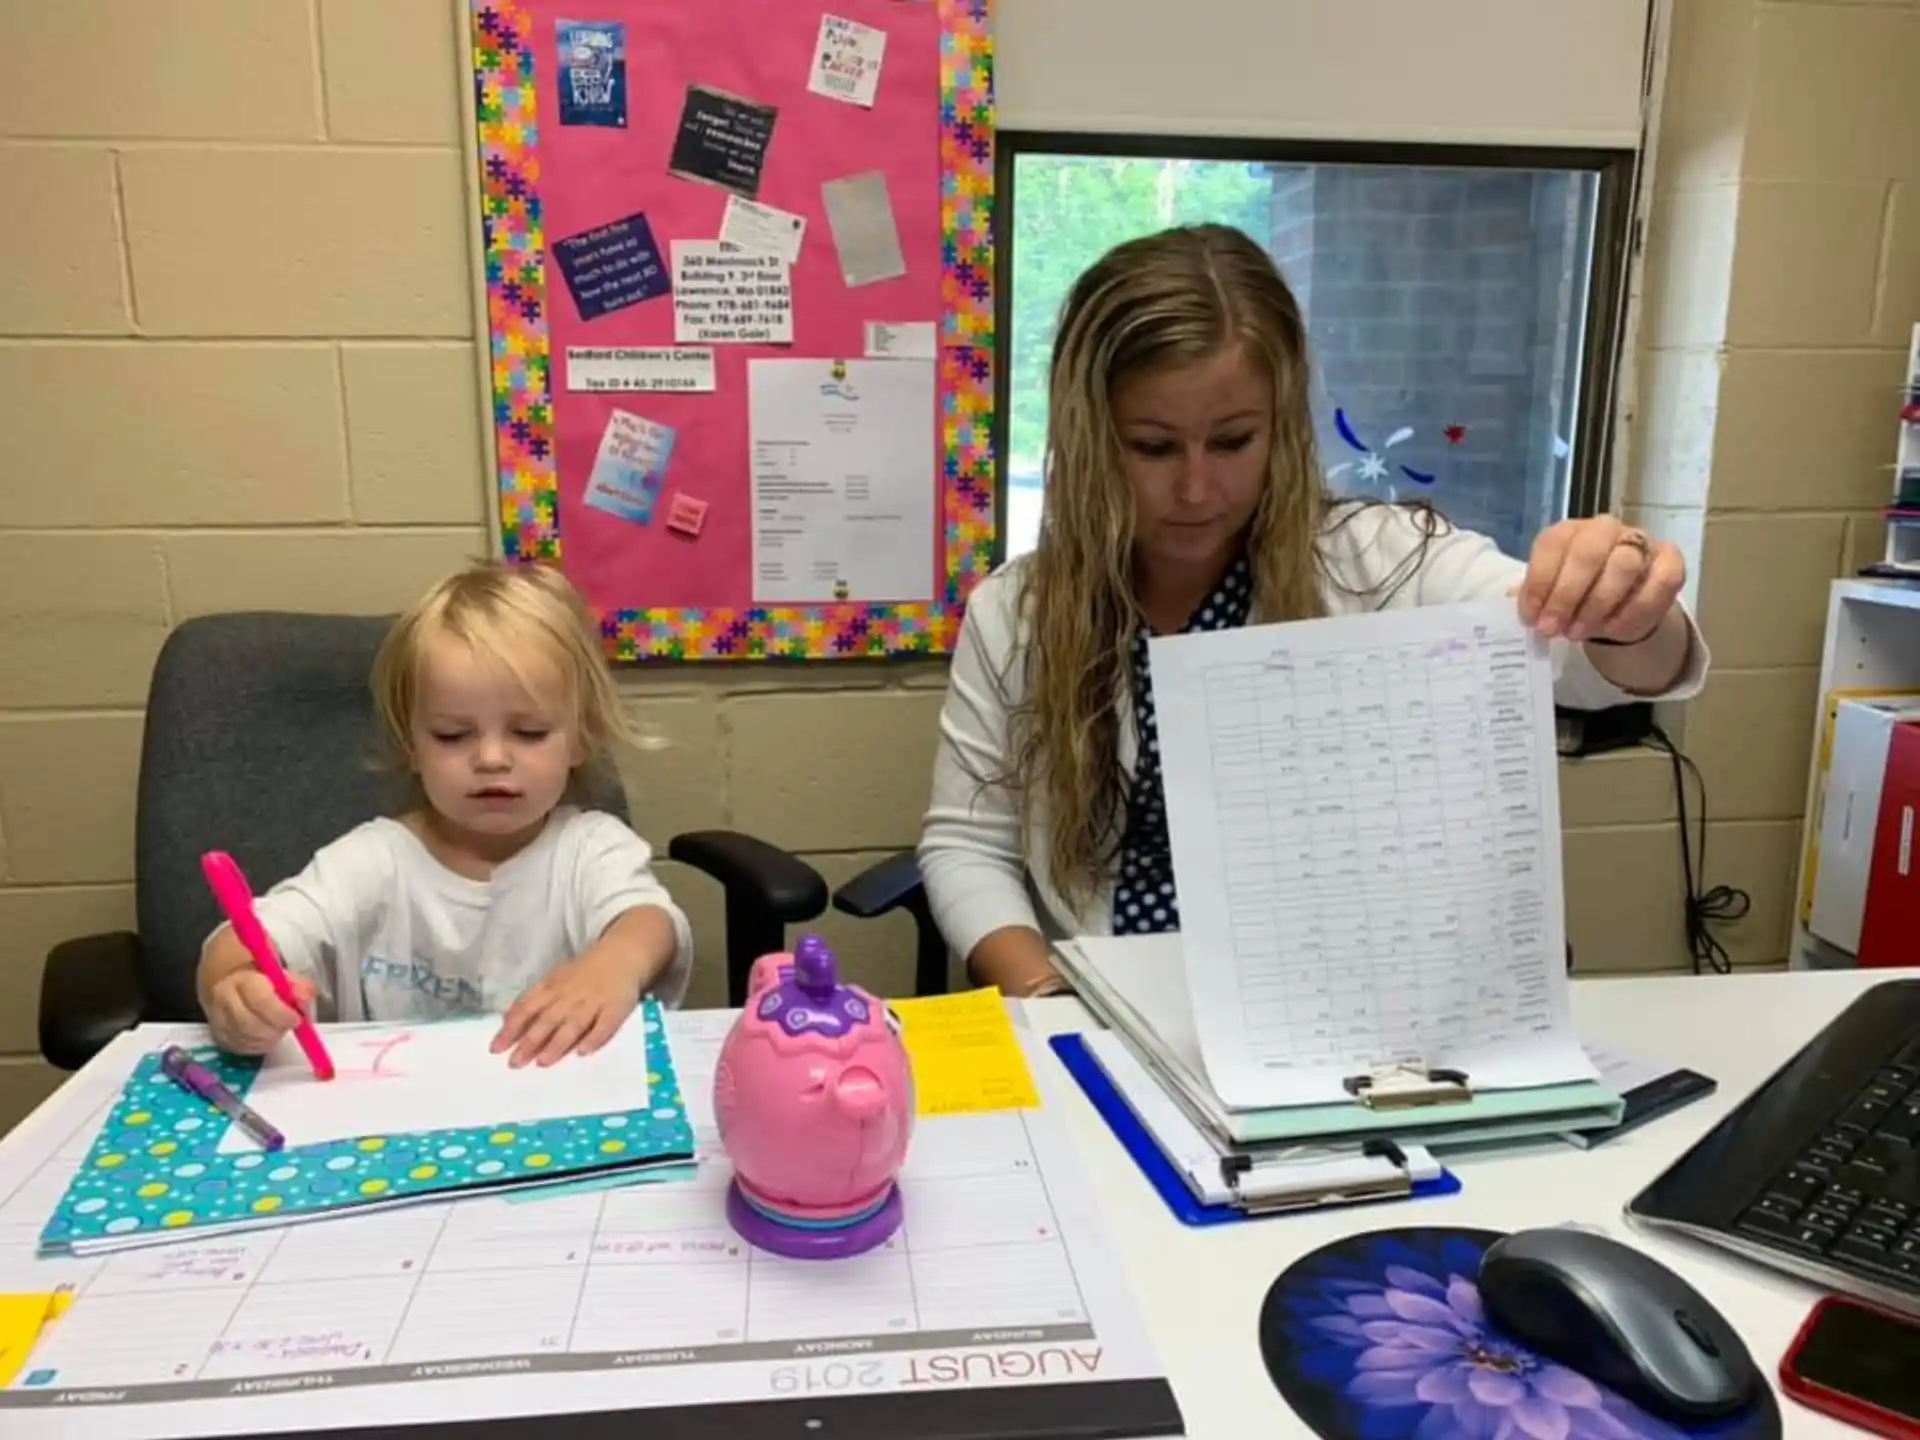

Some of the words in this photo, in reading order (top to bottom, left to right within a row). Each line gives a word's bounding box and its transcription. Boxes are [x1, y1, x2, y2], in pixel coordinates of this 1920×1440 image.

[612, 1350, 698, 1364] TUESDAY
[794, 1339, 875, 1354] MONDAY
[770, 1360, 884, 1395] 2019
[899, 1347, 1104, 1386] AUGUST
